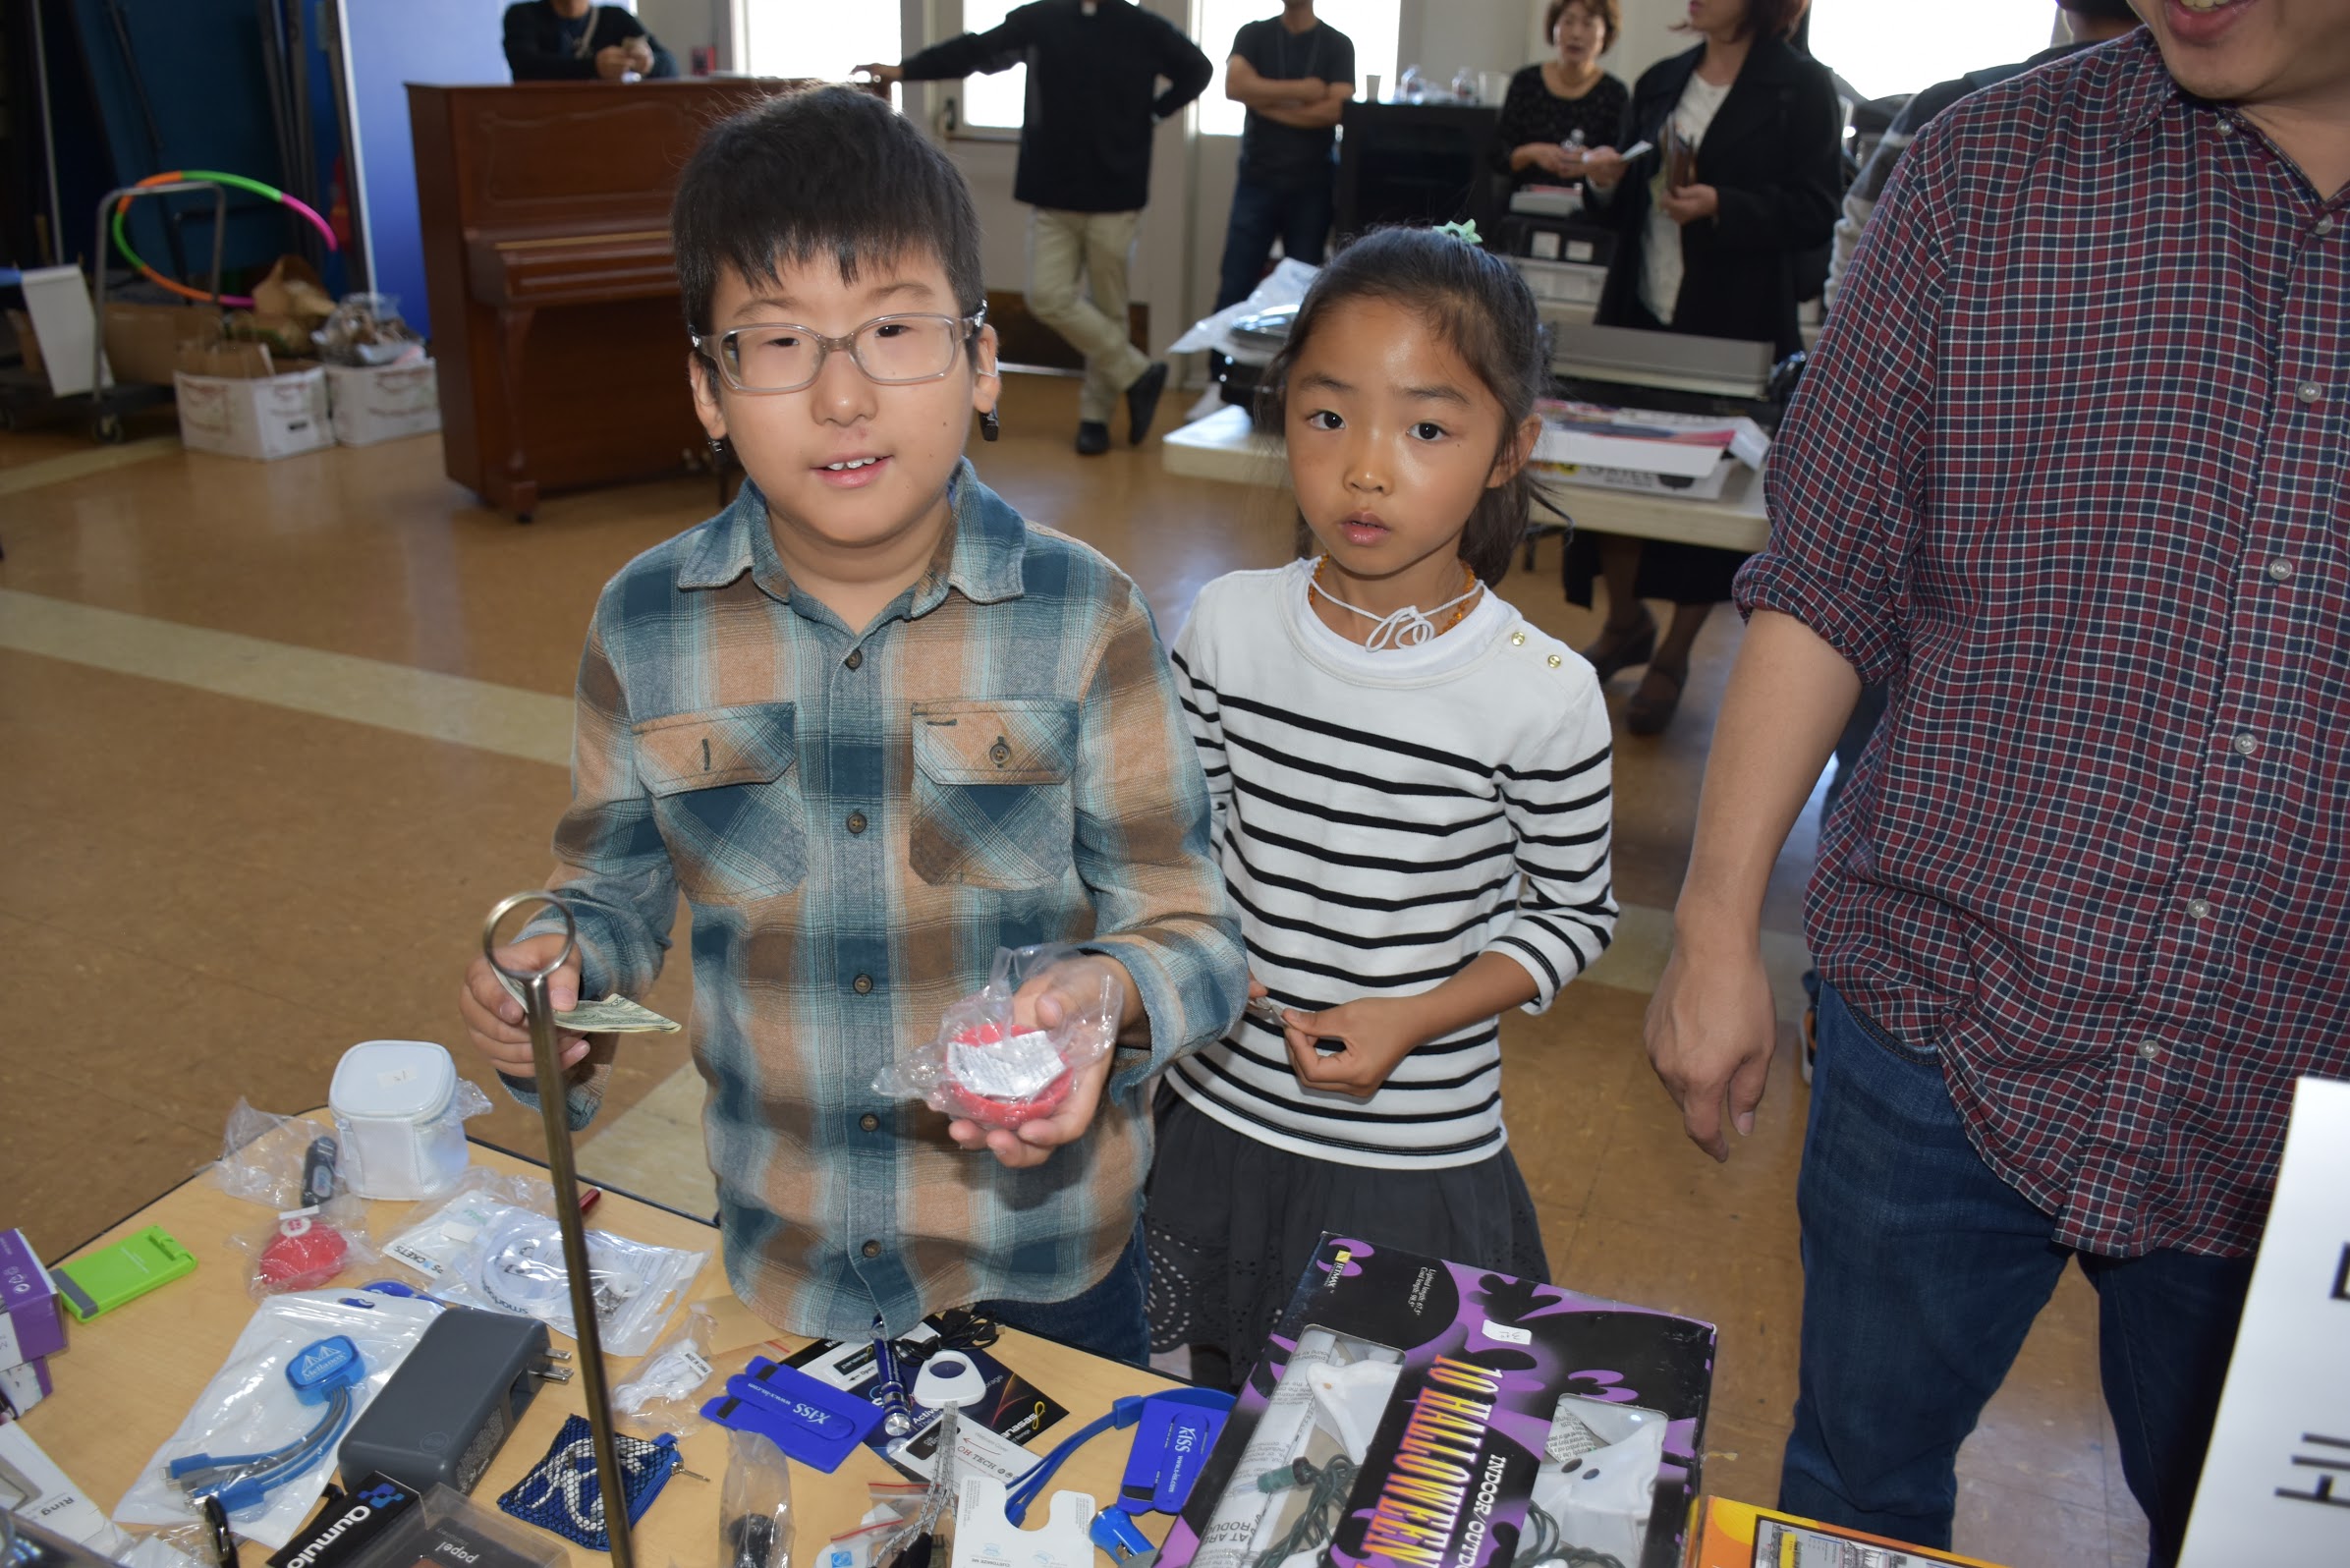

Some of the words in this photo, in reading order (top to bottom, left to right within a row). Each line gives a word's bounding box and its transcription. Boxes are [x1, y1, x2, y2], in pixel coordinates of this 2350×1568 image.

[1328, 1262, 1345, 1288] JETMAX
[984, 1374, 1004, 1389] orage
[1427, 1353, 1504, 1394] 10
[793, 1403, 831, 1425] X-ISS
[1000, 1412, 1038, 1439] anasas
[1175, 1427, 1197, 1452] X-ISS
[1360, 1385, 1493, 1568] HALLOWEEN
[41, 1497, 75, 1516] Ring
[286, 1505, 371, 1568] Qumulo
[434, 1540, 479, 1564] papel
